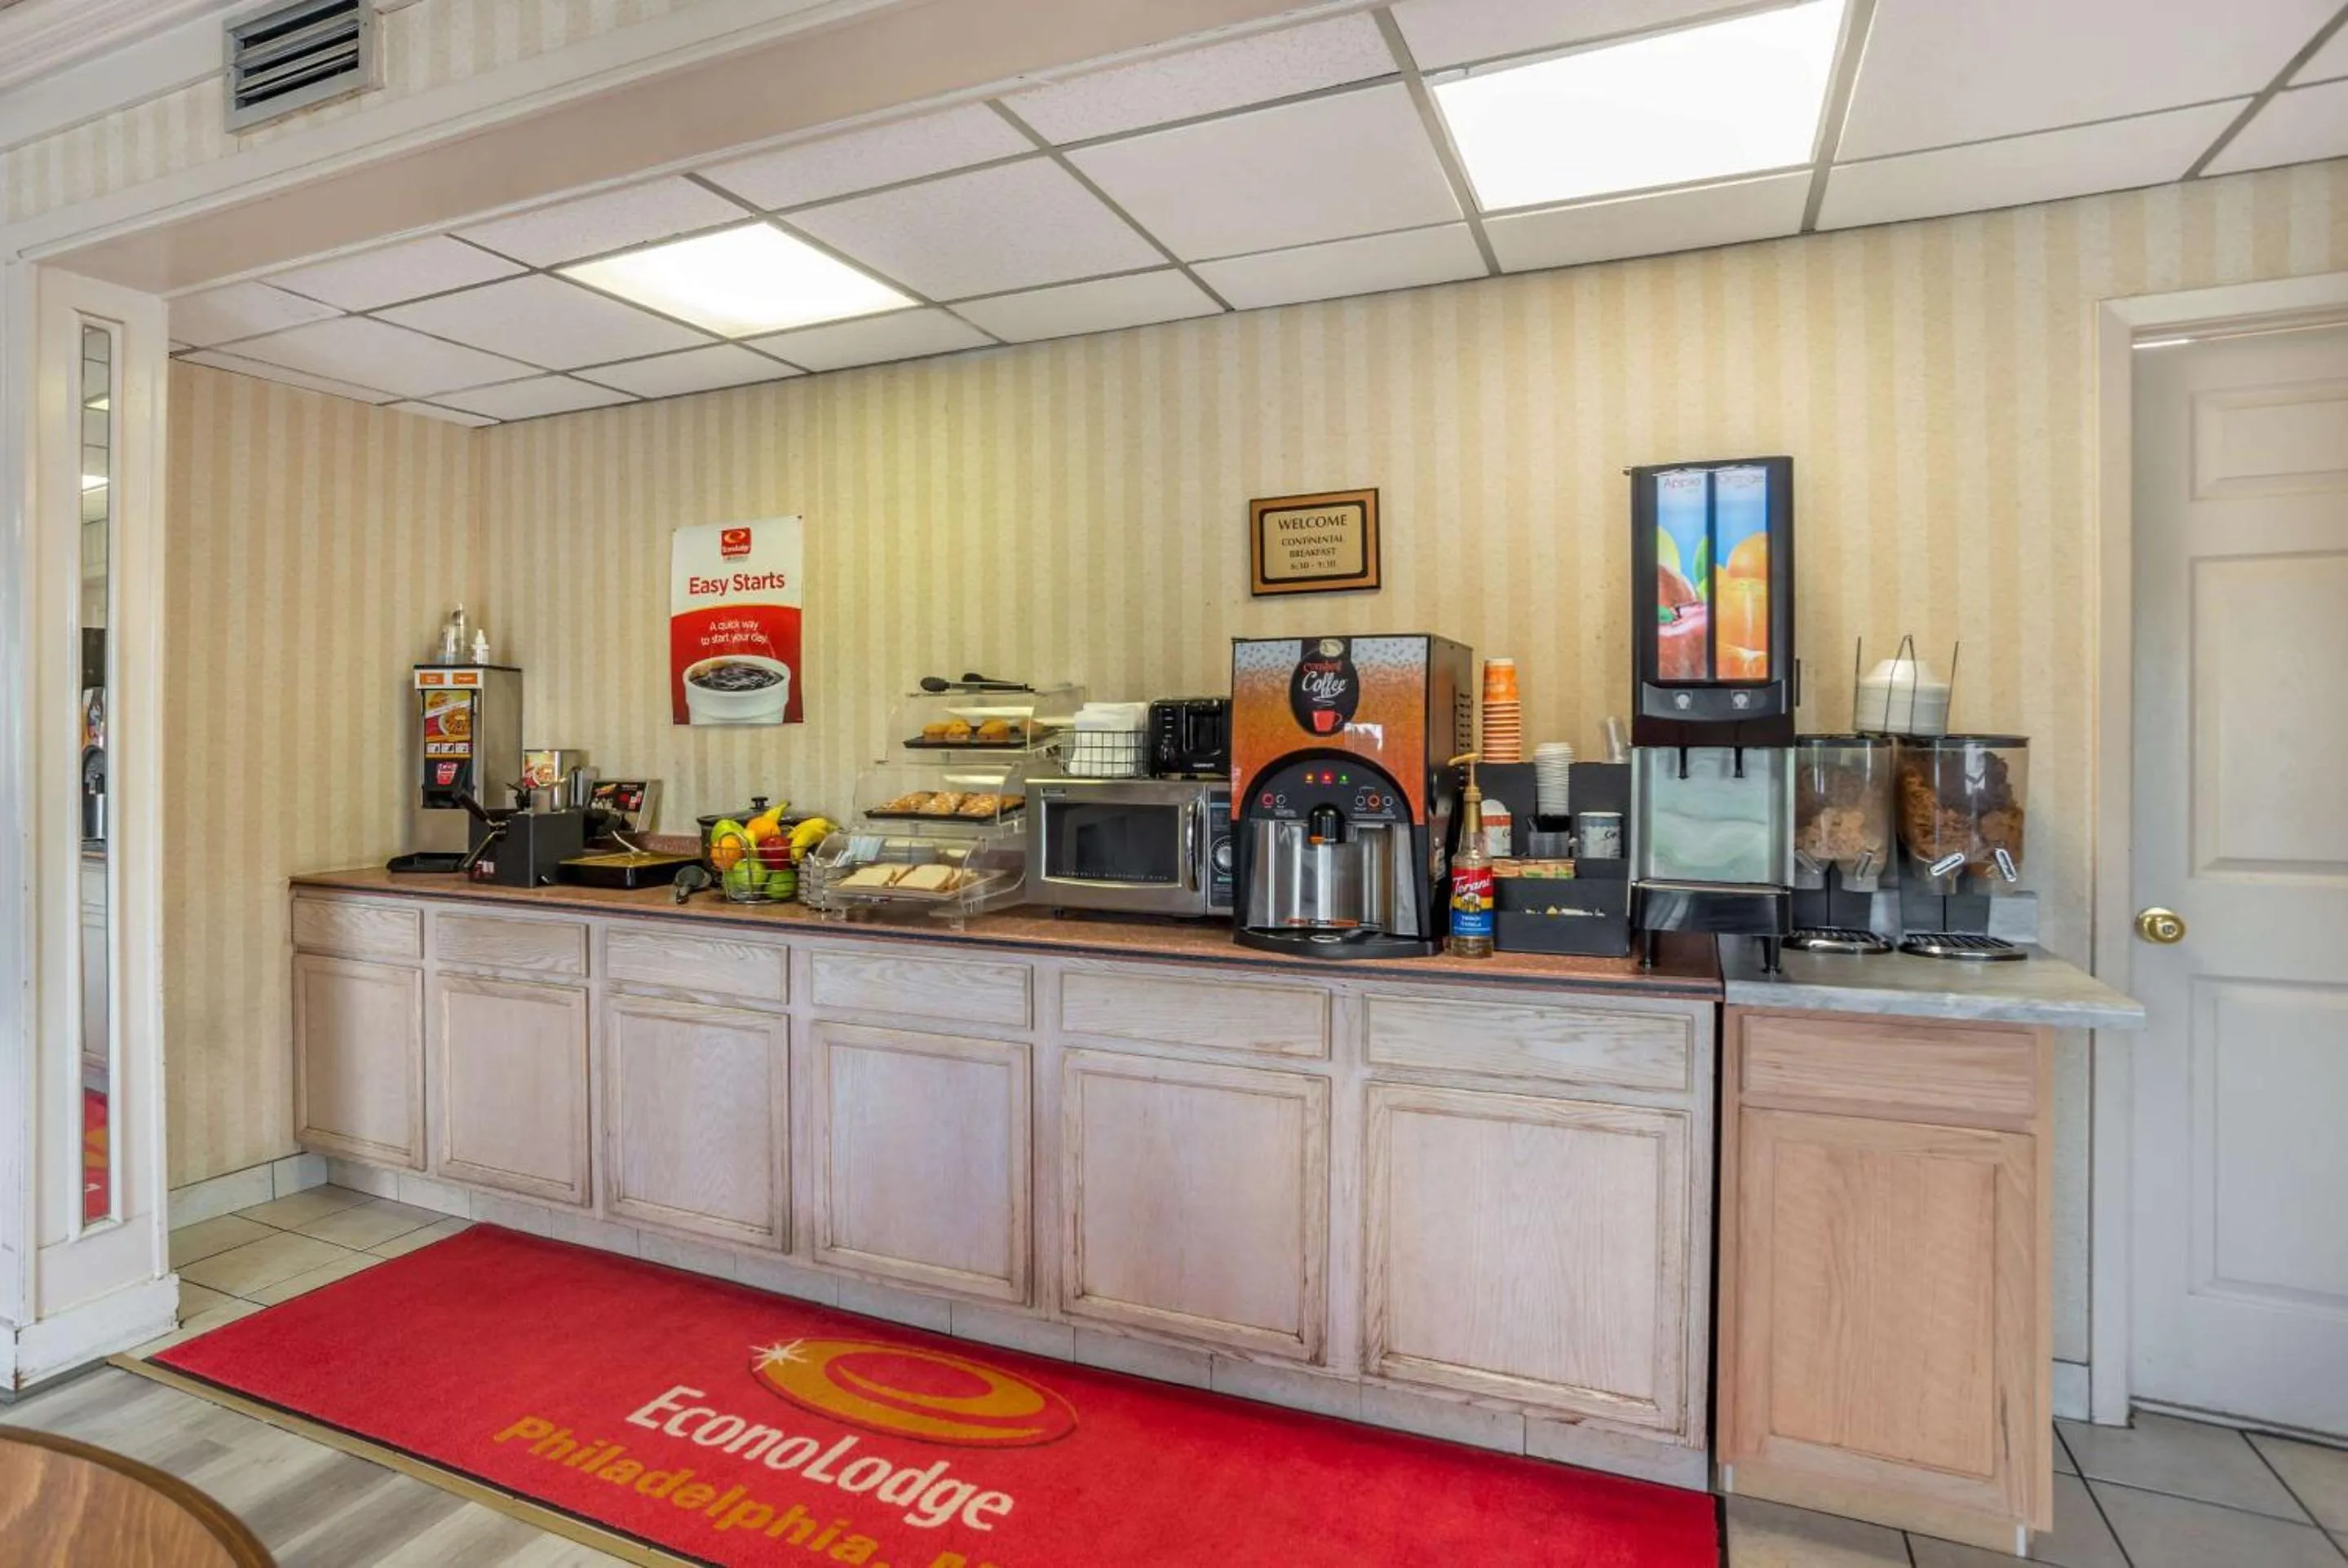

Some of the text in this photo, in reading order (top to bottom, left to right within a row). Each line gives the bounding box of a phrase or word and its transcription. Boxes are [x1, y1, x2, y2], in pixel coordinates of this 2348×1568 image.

[1278, 515, 1347, 530] WELCOME
[1281, 535, 1344, 546] CONTINENTAL
[1289, 547, 1337, 559] BREAKFAST
[689, 572, 785, 596] Easy Starts
[710, 620, 759, 631] A quick way
[701, 636, 710, 646] to
[711, 633, 729, 644] start
[732, 633, 750, 644] your
[1302, 670, 1348, 699] Coffee
[1452, 874, 1491, 896] Torani
[626, 1385, 1014, 1531] EconoLodge
